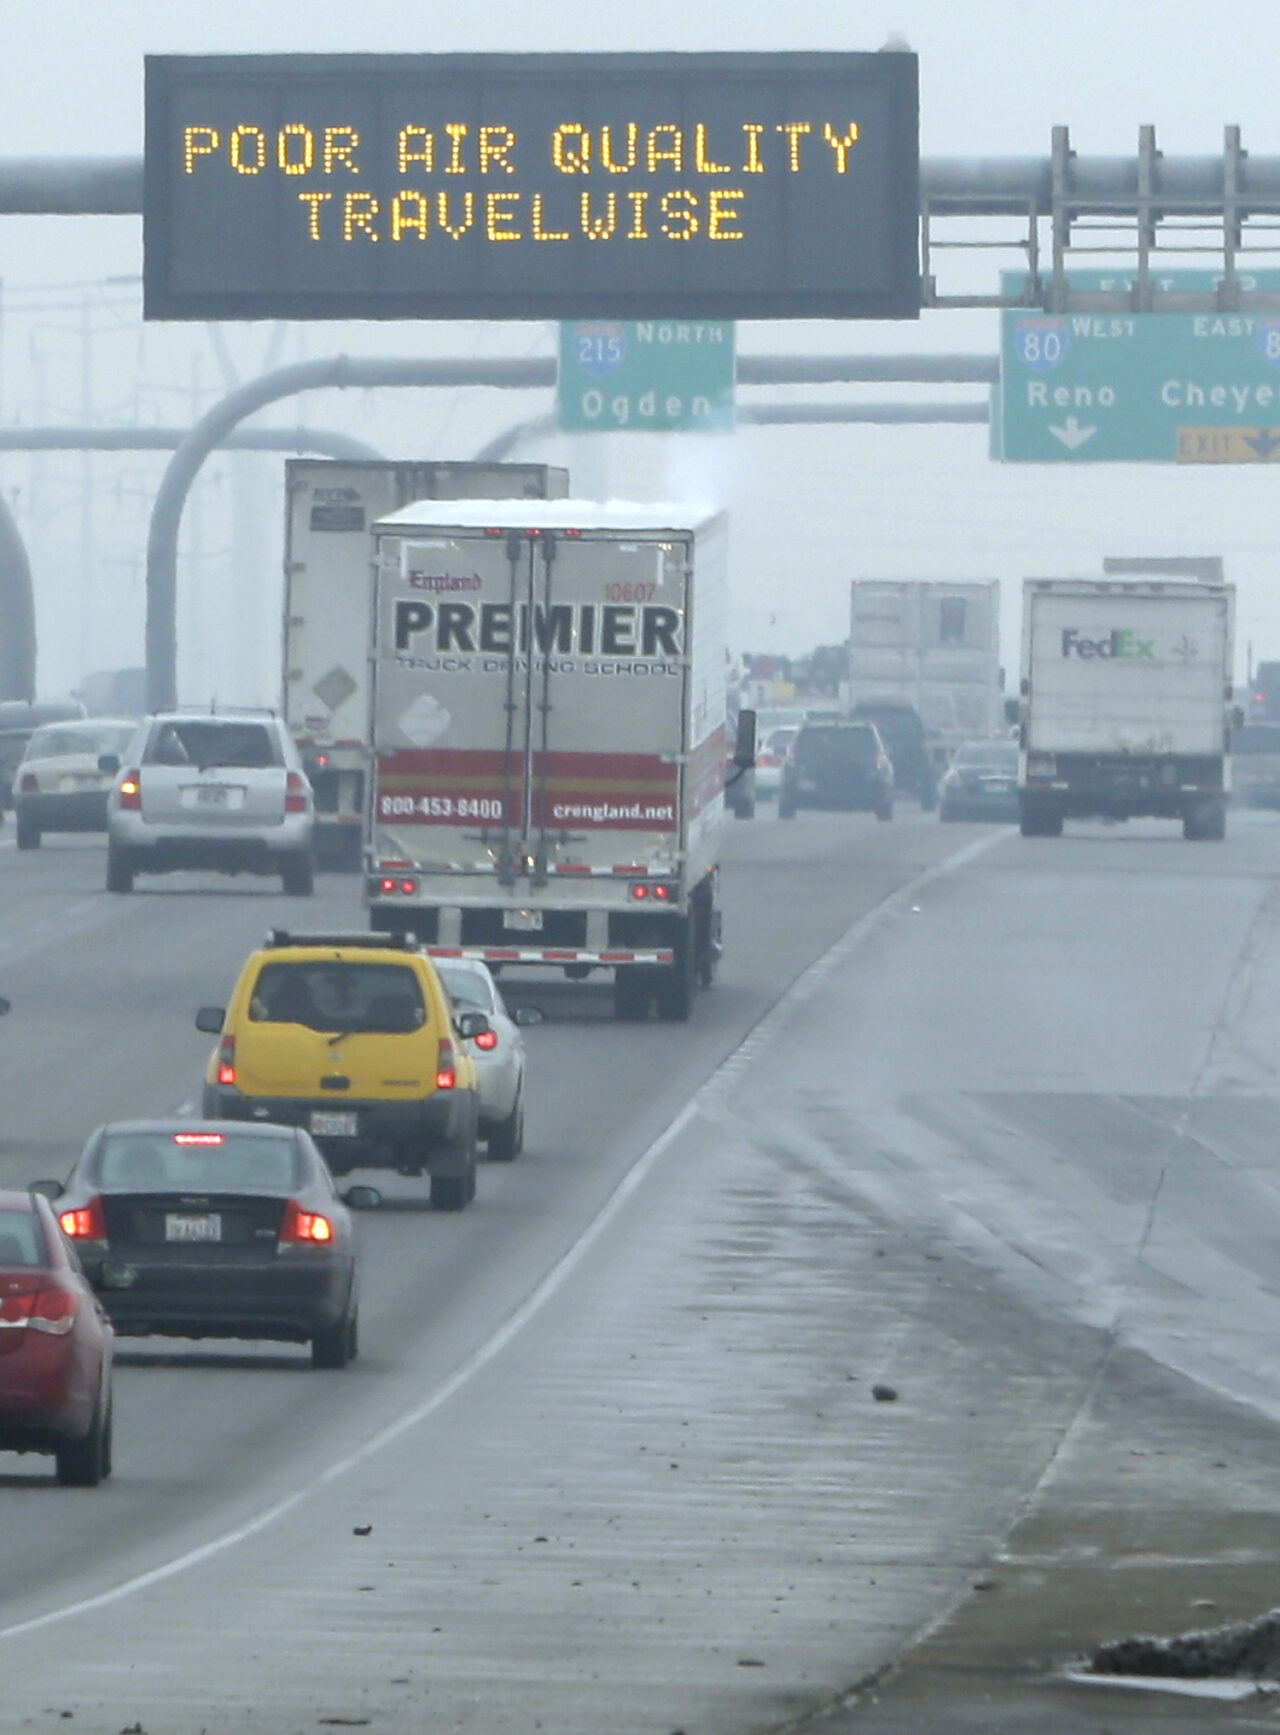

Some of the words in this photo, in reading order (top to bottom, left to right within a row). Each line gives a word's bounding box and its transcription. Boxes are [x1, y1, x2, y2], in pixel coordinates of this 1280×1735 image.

[183, 123, 361, 176] POOR
[397, 123, 516, 175] AIR
[551, 122, 860, 175] QUALITY
[298, 189, 745, 242] TRAVELWISE
[637, 322, 723, 343] NORTH
[1072, 318, 1135, 338] WEST
[1194, 317, 1255, 337] EAST
[579, 336, 621, 363] 215
[1024, 332, 1061, 362] 80
[582, 389, 711, 424] Ogden
[1027, 381, 1115, 407] Reno
[1161, 379, 1280, 414] Cheye
[1180, 434, 1233, 455] EXIT
[409, 570, 483, 594] England
[606, 582, 657, 602] 10607
[395, 600, 683, 656] PREMIER
[1062, 629, 1155, 660] FedEx
[397, 656, 472, 673] TRUCK
[483, 658, 575, 675] DRIVING
[584, 661, 678, 676] SCHOOL
[381, 796, 503, 820] 800-453-8400
[553, 802, 674, 823] crengland.net
